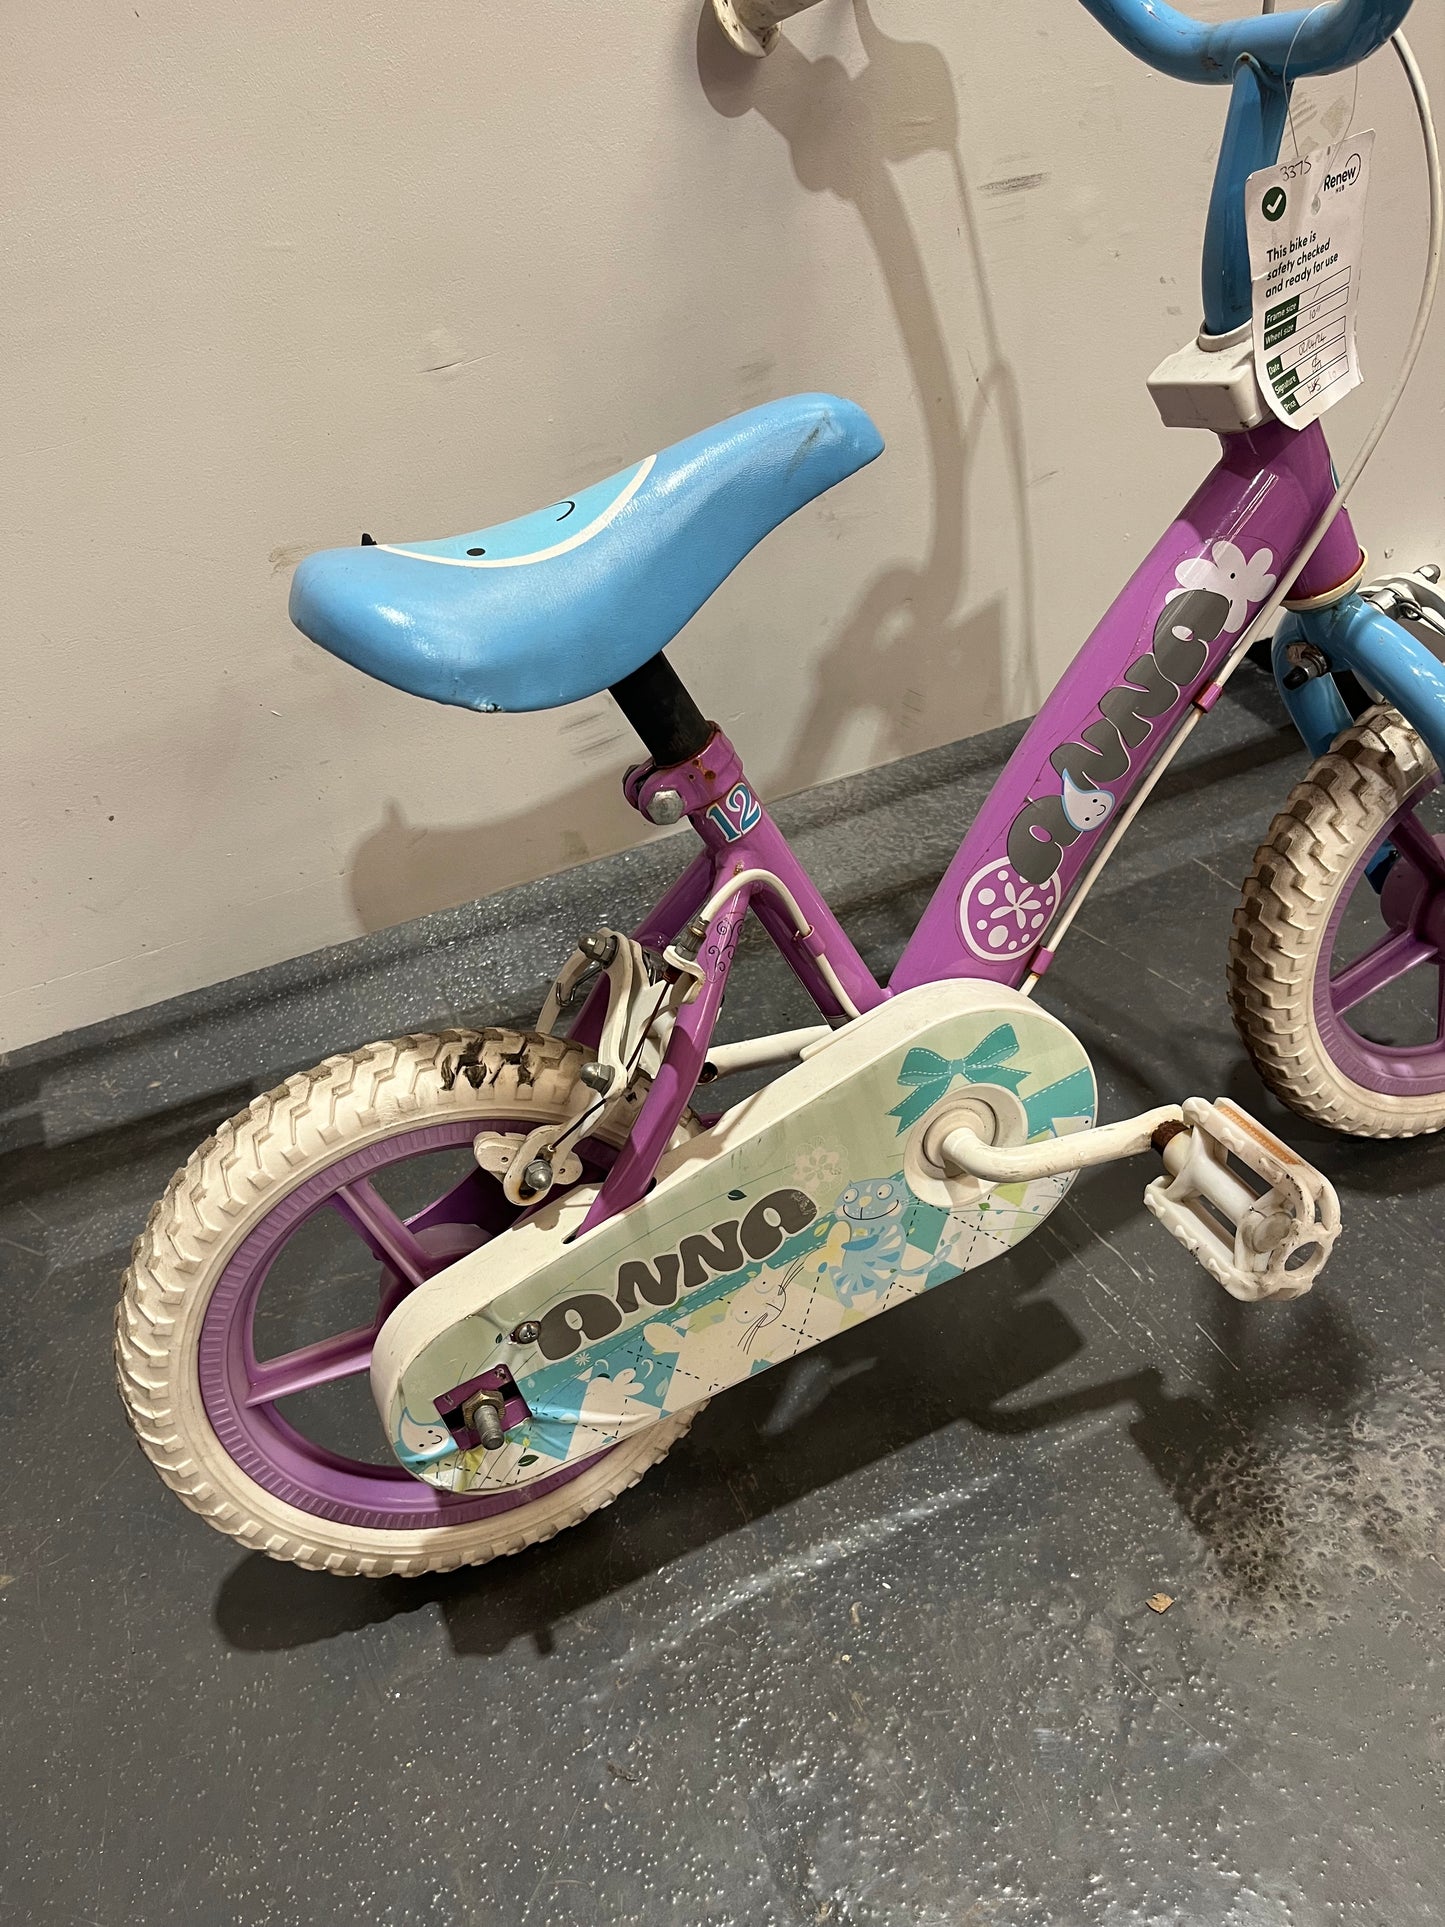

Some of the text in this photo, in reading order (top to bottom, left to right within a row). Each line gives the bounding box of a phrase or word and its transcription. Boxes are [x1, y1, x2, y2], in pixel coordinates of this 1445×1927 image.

[1323, 166, 1357, 191] Renew
[1335, 185, 1345, 194] HUB
[1266, 230, 1317, 263] This bike is
[1266, 237, 1331, 281] safety checked
[1265, 253, 1339, 298] and ready for use
[1266, 302, 1297, 324] Frame size
[1265, 323, 1294, 345] Wheel size
[1268, 362, 1281, 375] Date
[1274, 375, 1297, 395] Signature
[1283, 400, 1297, 412] Price
[706, 782, 762, 843] 12
